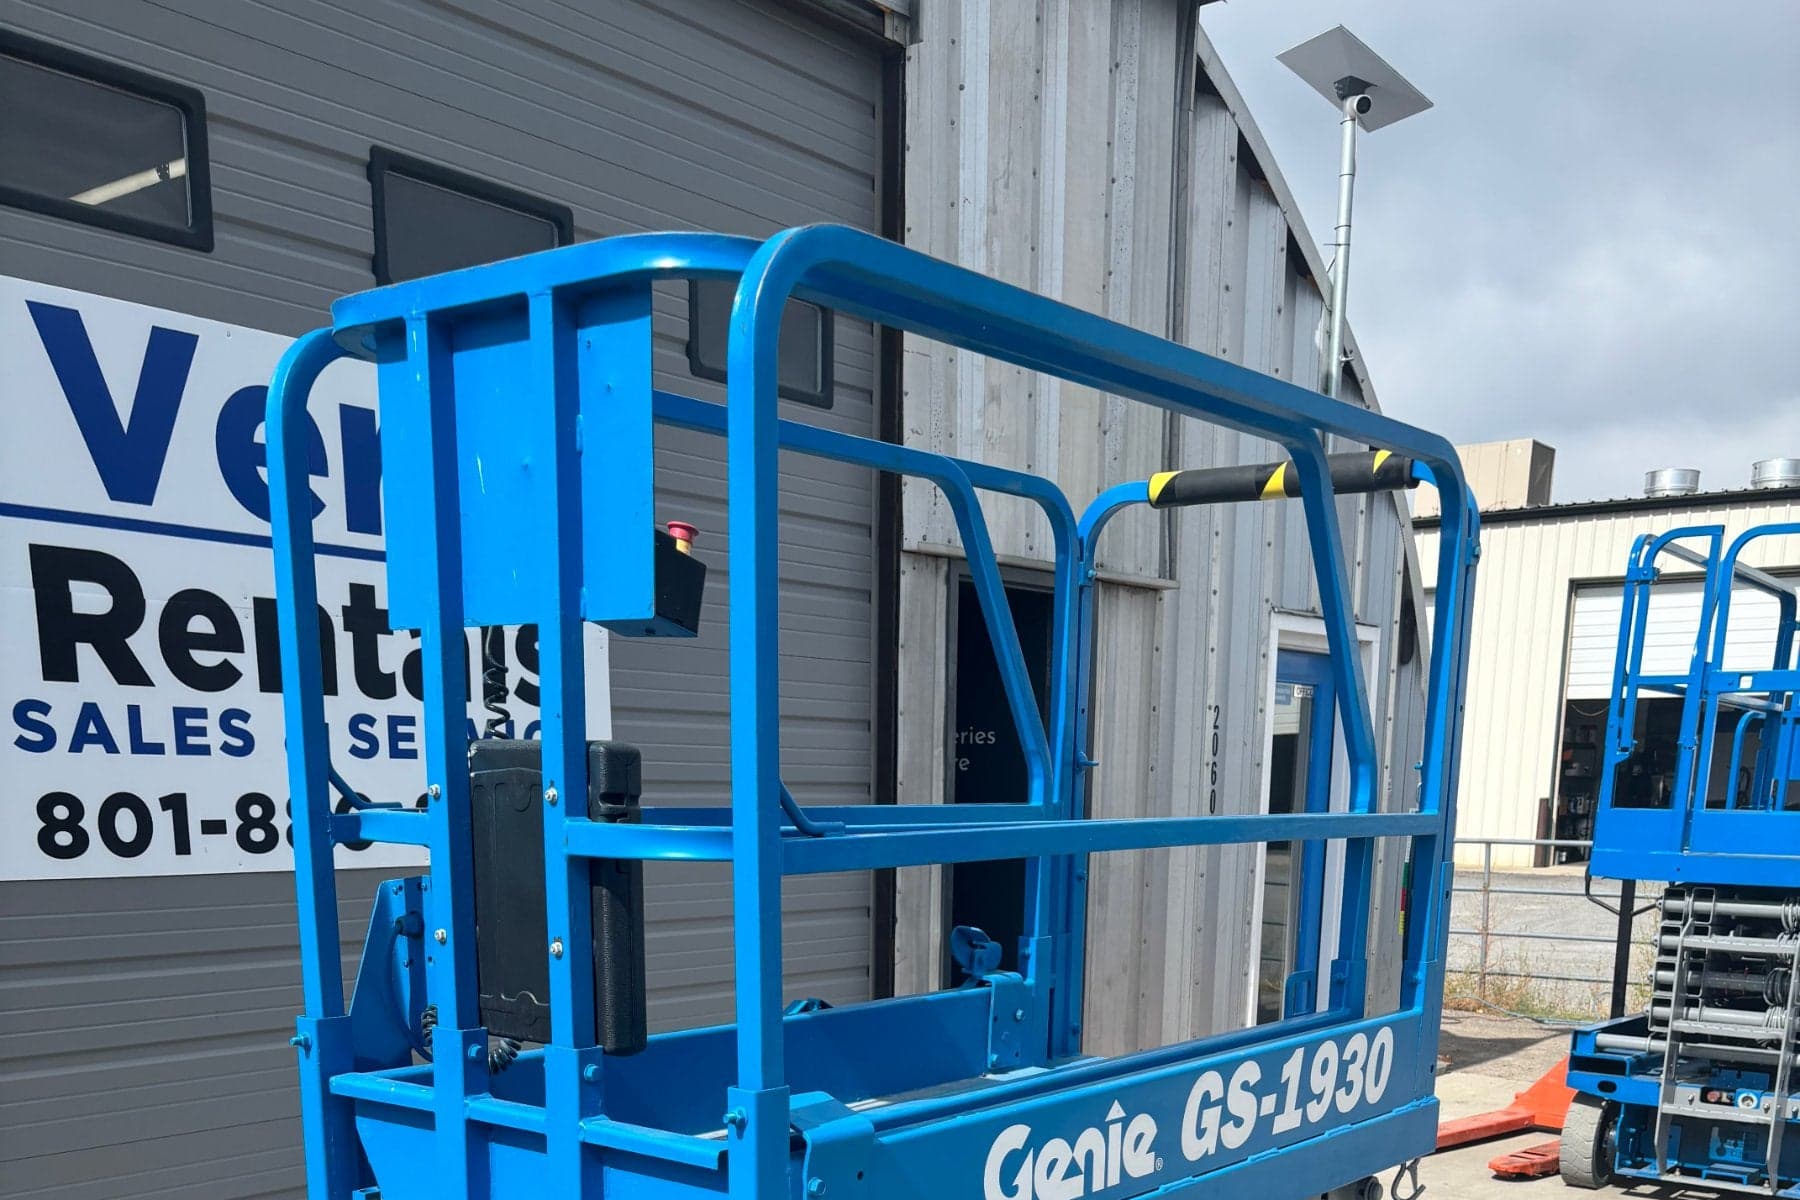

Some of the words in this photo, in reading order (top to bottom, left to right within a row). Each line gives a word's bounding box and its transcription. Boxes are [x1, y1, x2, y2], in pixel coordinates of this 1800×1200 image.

[12, 699, 256, 757] SALES
[1209, 704, 1220, 815] 2060
[1181, 1026, 1394, 1162] GS-1930
